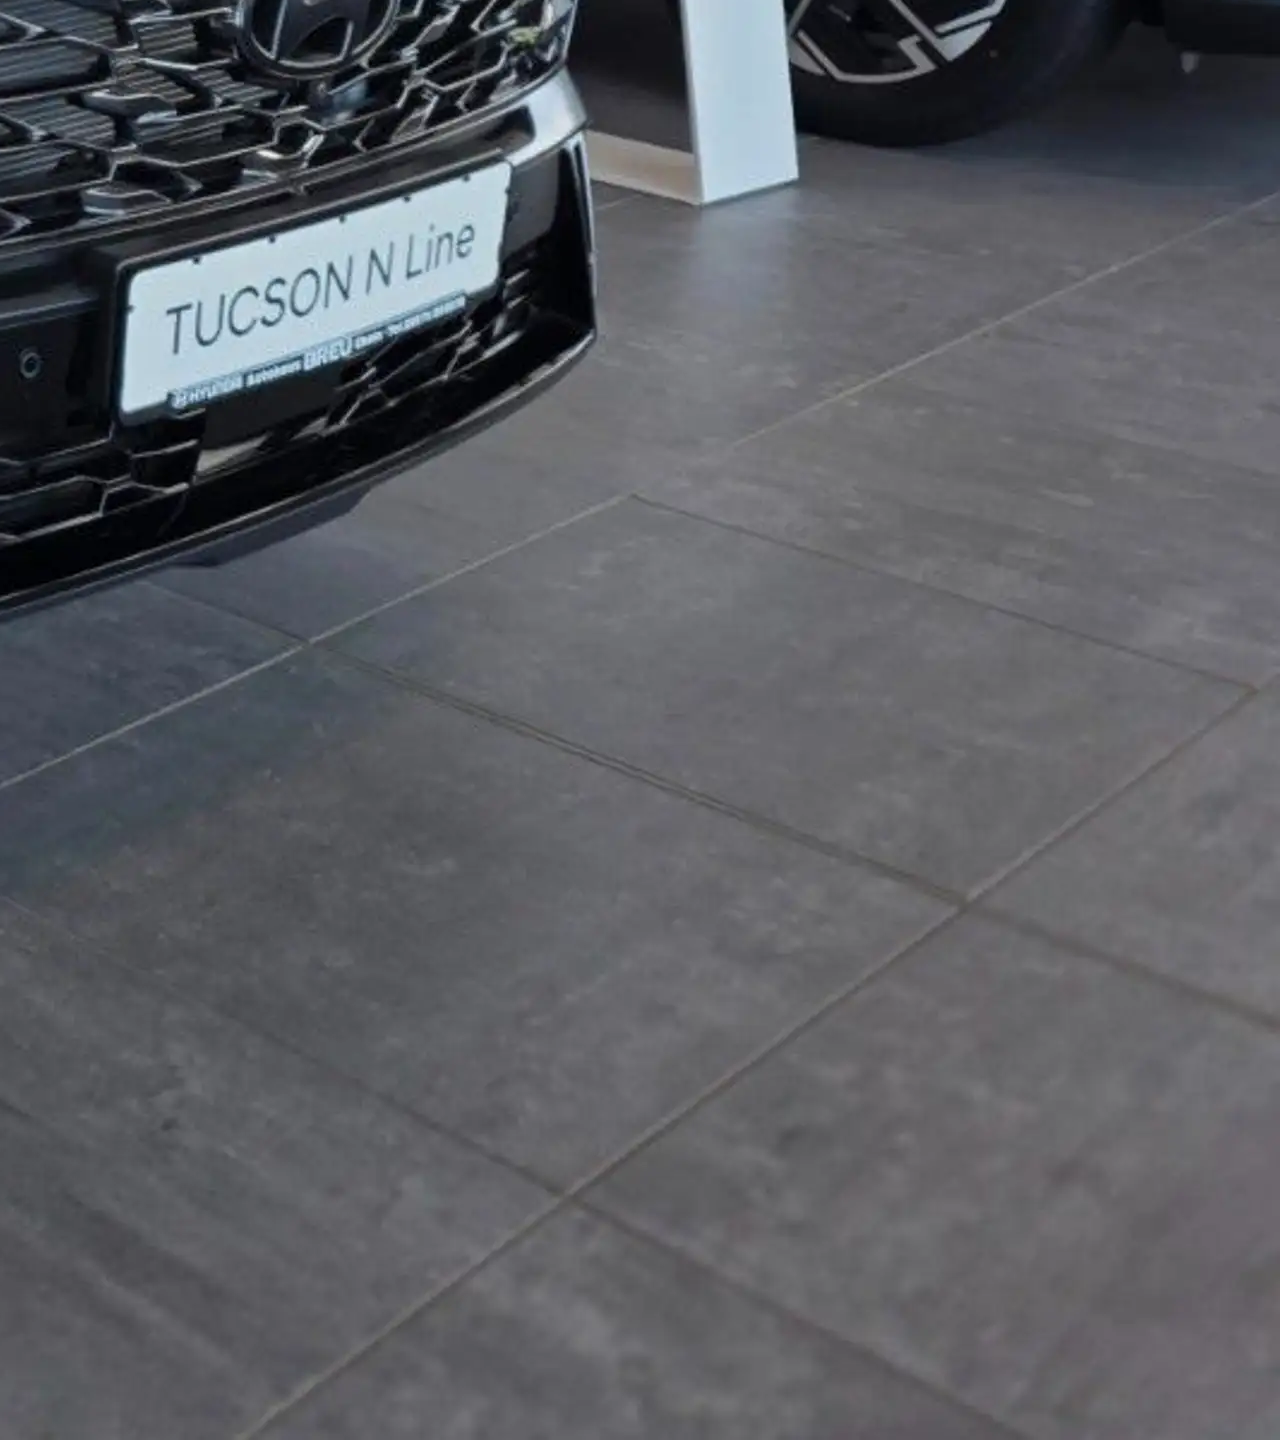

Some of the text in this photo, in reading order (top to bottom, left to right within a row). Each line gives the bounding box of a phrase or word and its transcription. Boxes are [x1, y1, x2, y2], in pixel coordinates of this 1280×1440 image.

[166, 254, 353, 355] TUCSON
[366, 241, 395, 294] N
[405, 223, 476, 281] Line
